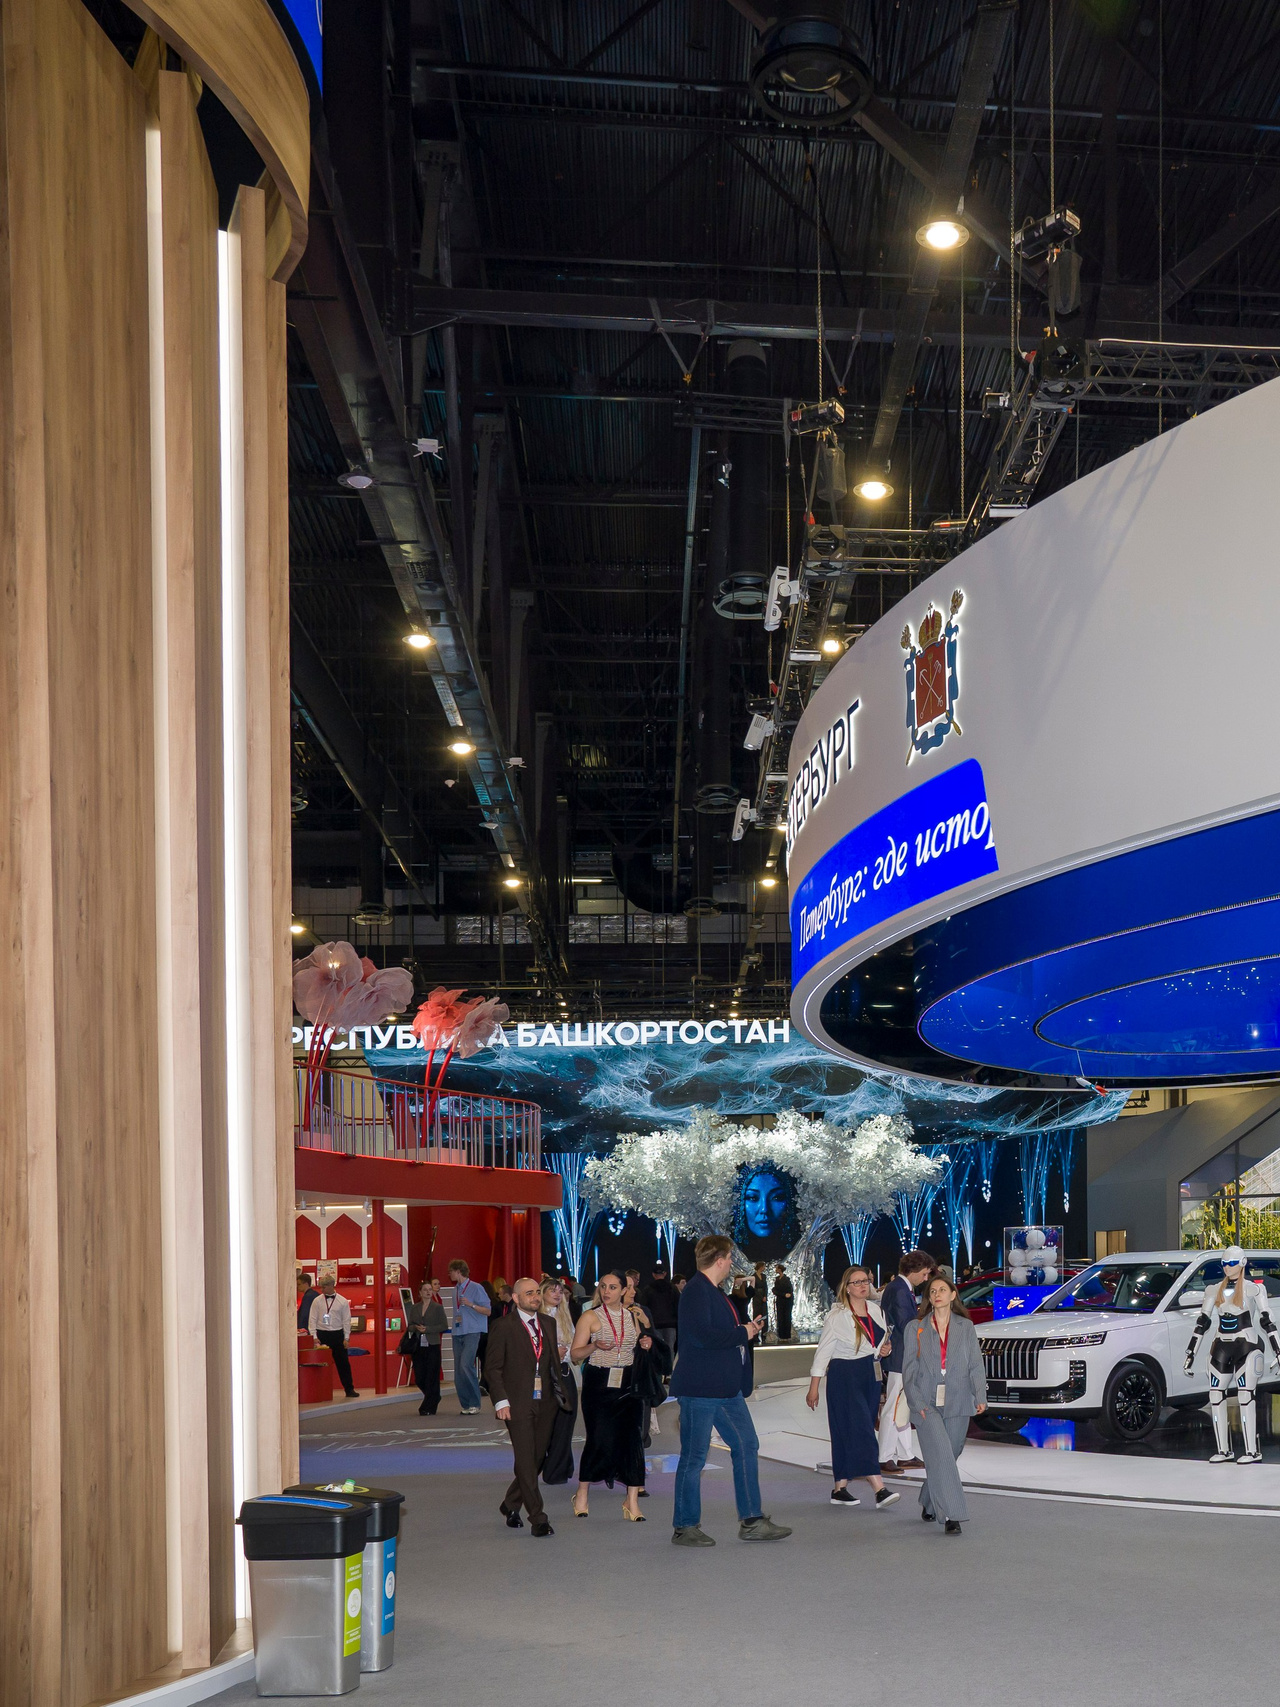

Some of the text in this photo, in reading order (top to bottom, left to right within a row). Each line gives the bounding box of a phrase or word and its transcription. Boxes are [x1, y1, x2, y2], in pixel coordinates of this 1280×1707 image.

[785, 698, 861, 853] ТЕРБУРГ
[799, 866, 868, 951] Петербург:
[872, 835, 908, 890] где
[518, 1019, 790, 1047] БАШКОРТОСТАН
